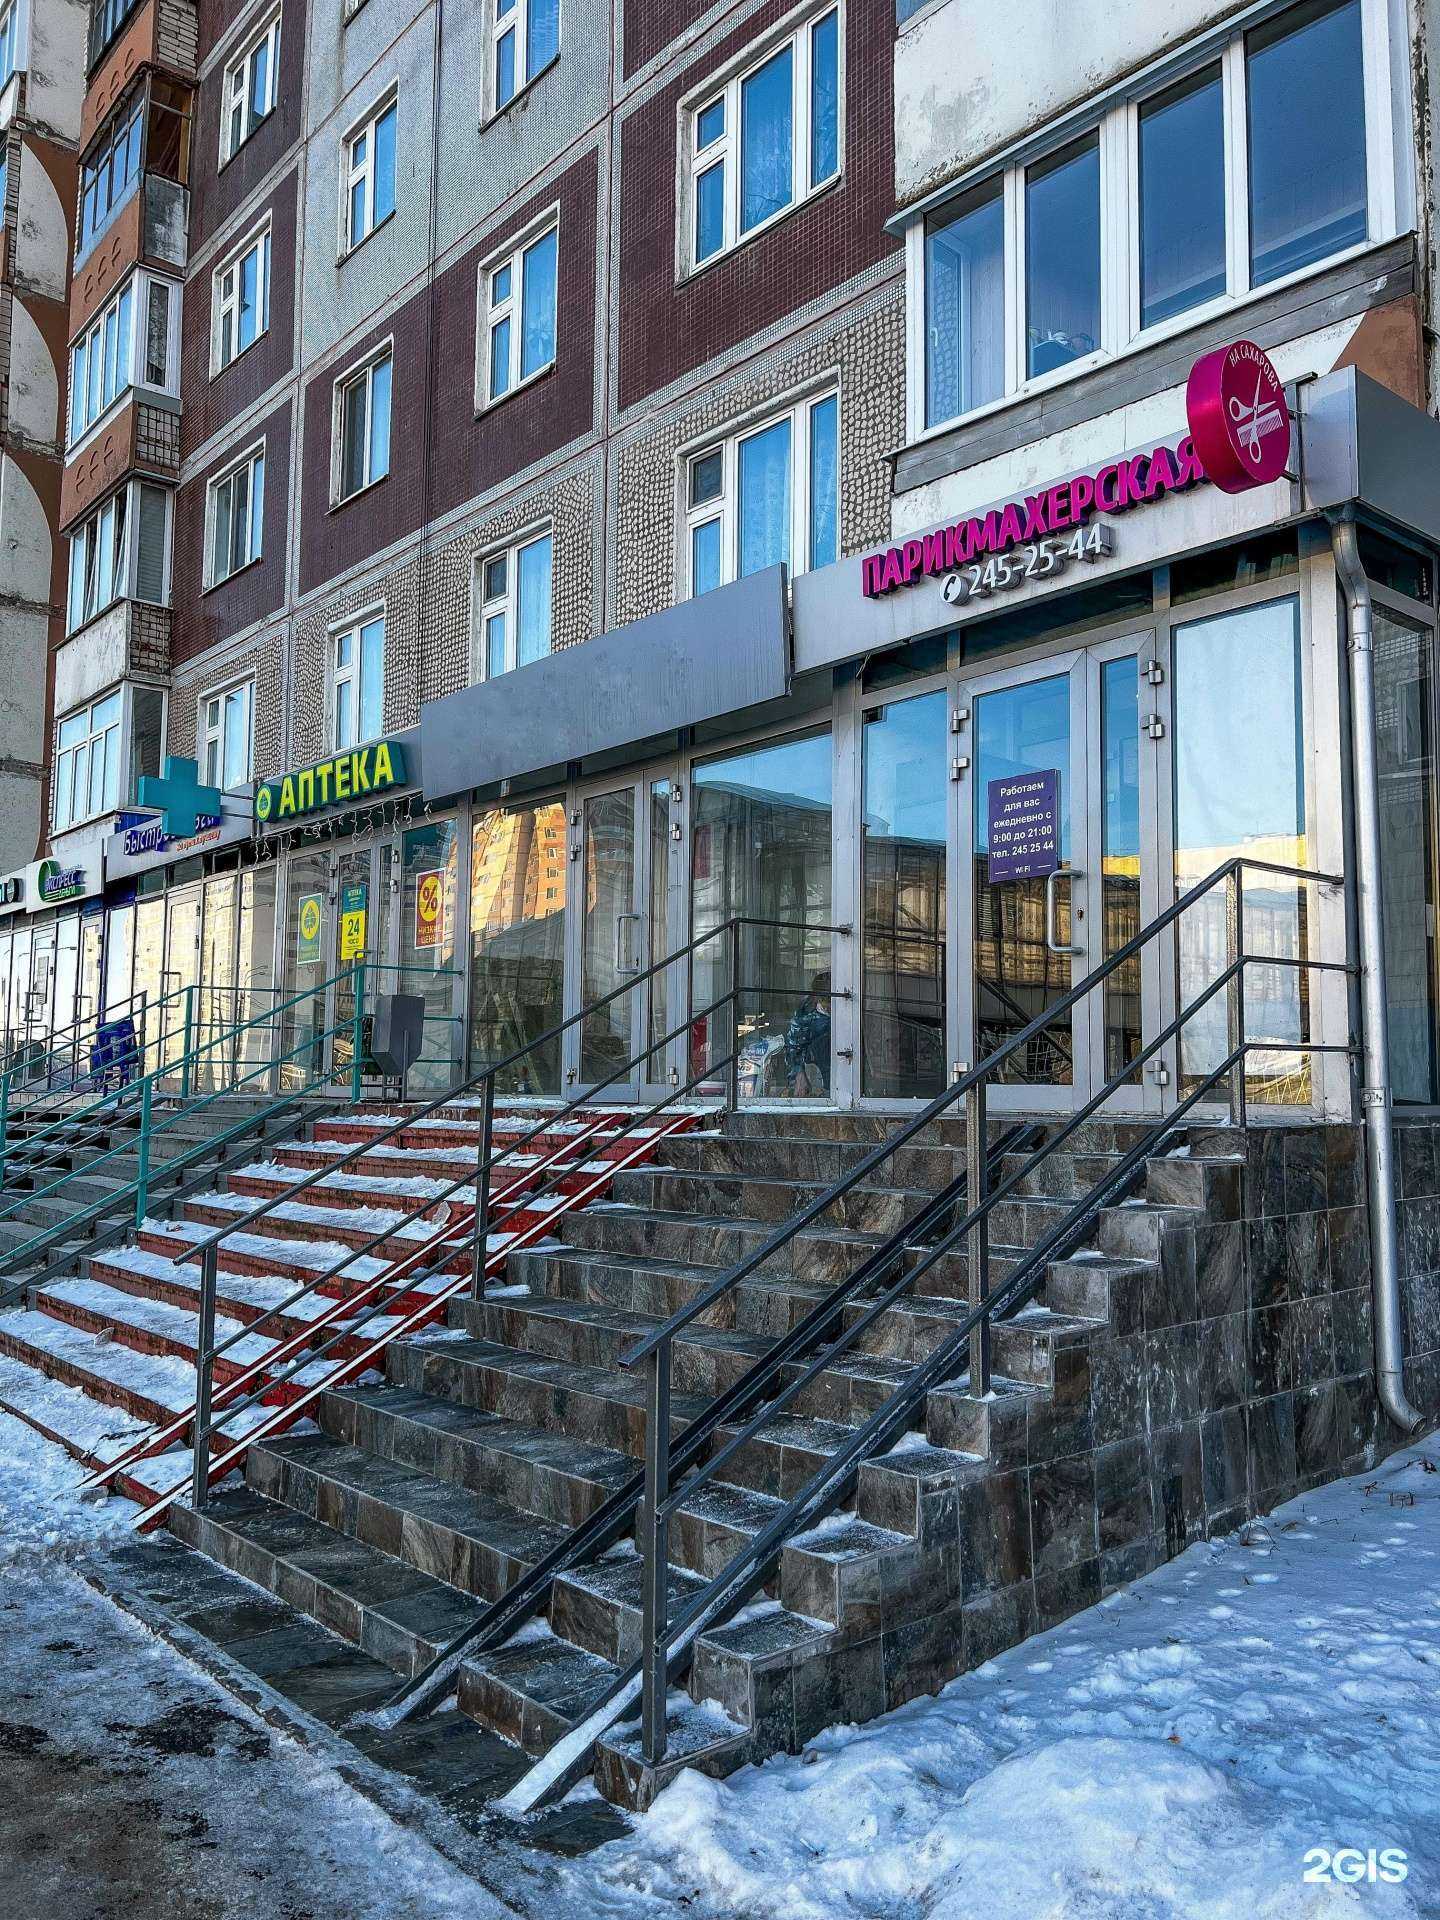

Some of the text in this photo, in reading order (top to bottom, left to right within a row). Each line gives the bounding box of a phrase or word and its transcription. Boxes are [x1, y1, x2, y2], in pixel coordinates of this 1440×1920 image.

[1229, 344, 1278, 392] НА САХАРОВА
[861, 436, 1204, 599] ПАРИКМАХЕРСКАЯ
[967, 523, 1104, 597] 245-25-44
[279, 742, 394, 817] АПТЕКА
[1000, 782, 1044, 797] Работаем
[1003, 798, 1041, 813] для вас
[993, 811, 1052, 829] ежедневно с
[993, 825, 1052, 844] 9:00 до 21:00
[992, 840, 1054, 859] тел. 245 25 44
[347, 918, 360, 937] 24
